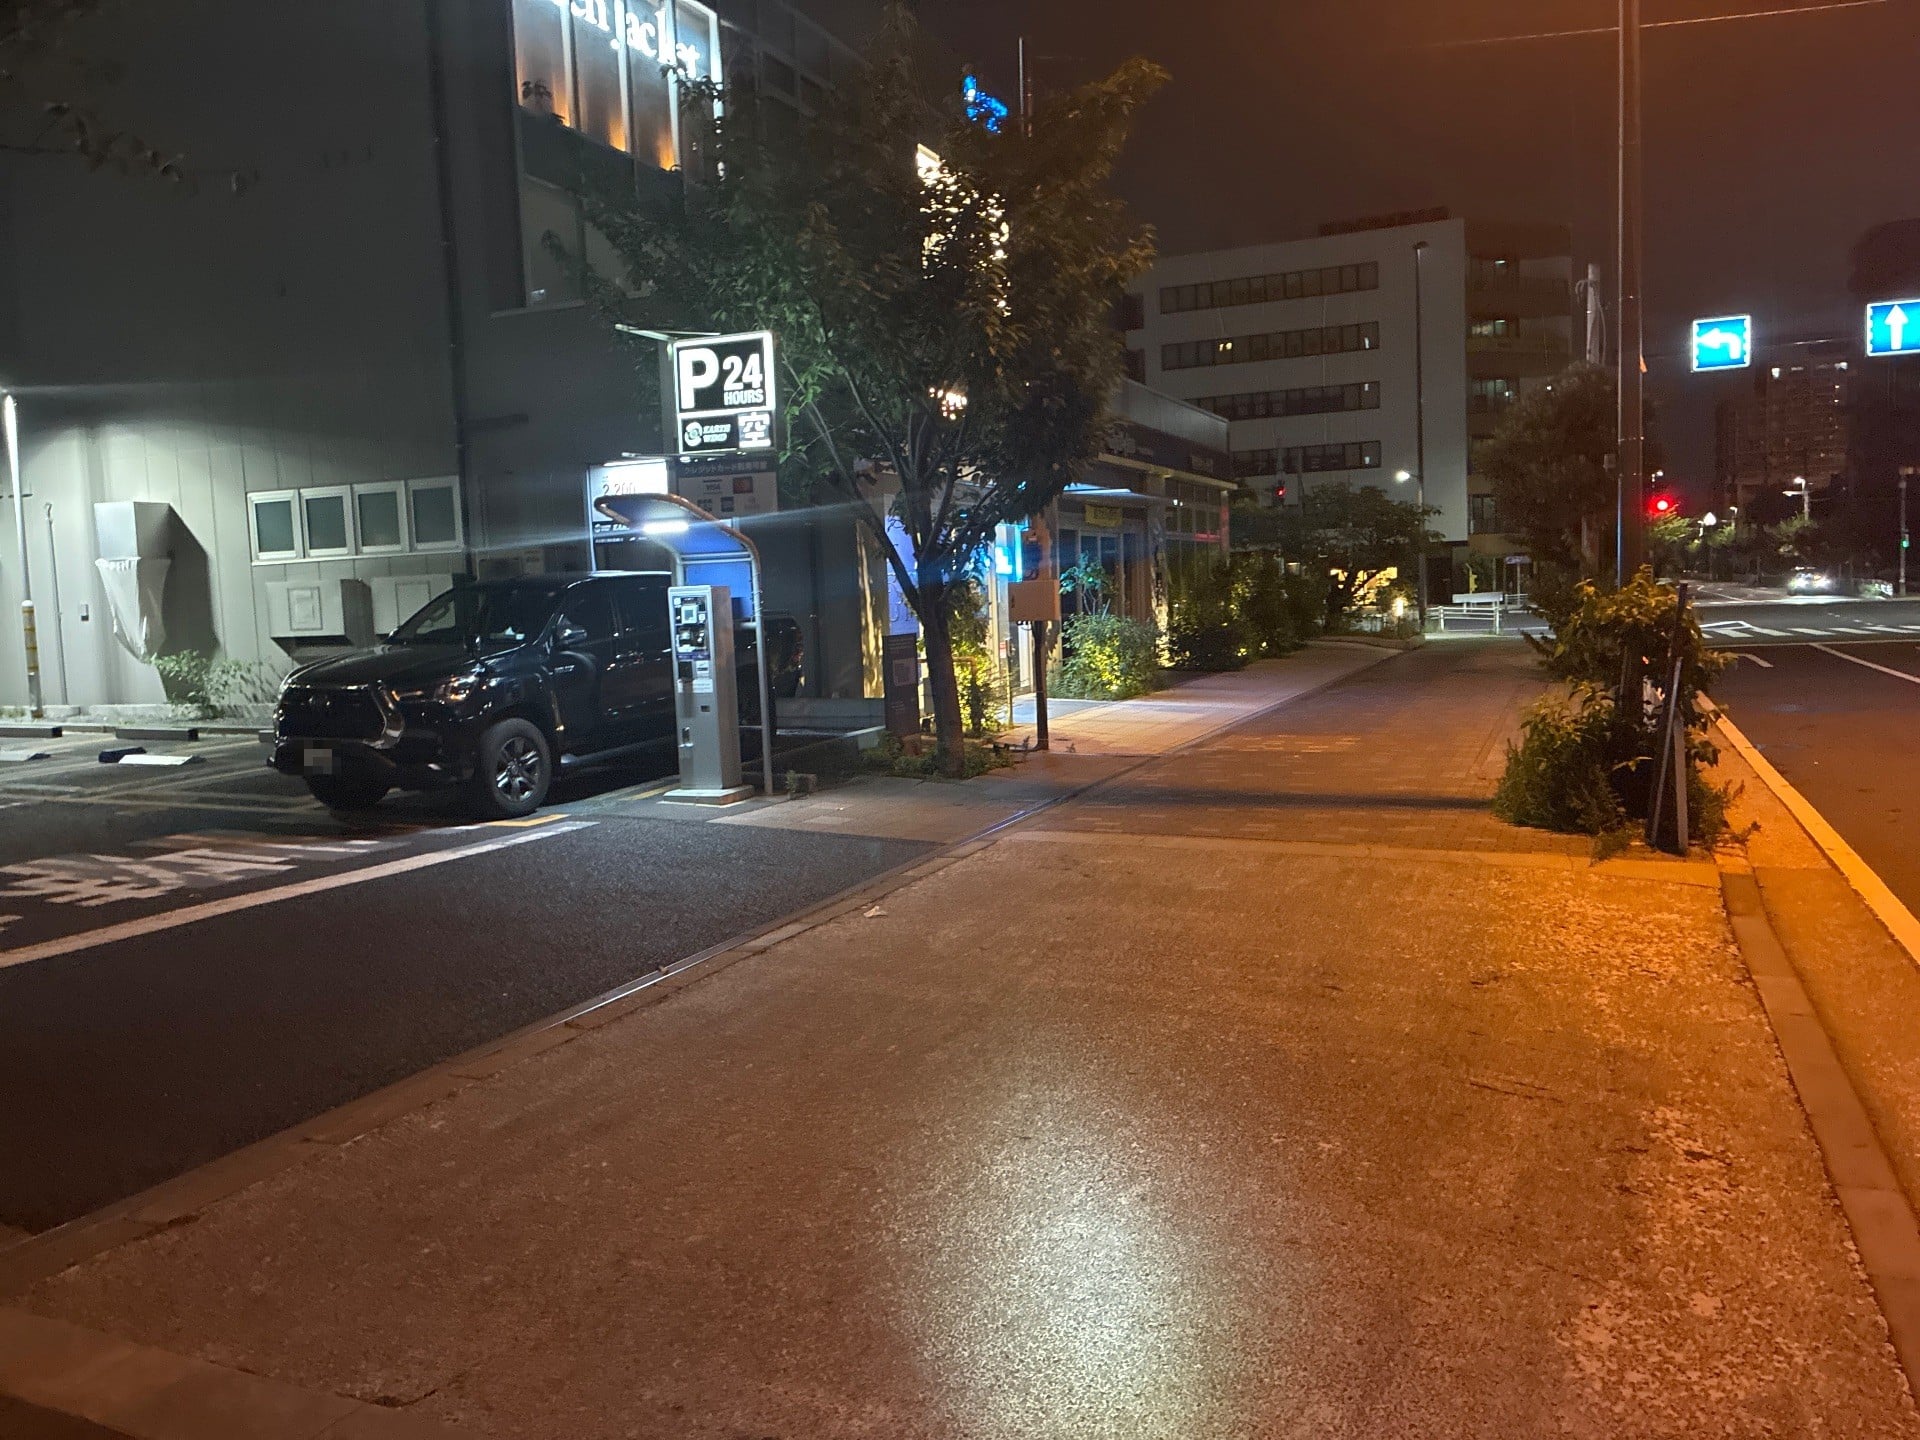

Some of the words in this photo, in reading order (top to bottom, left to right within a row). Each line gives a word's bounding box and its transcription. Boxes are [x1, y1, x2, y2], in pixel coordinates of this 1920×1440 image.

[678, 347, 719, 409] P
[722, 353, 763, 391] 24
[723, 389, 764, 406] HOURS
[738, 411, 771, 448] 空
